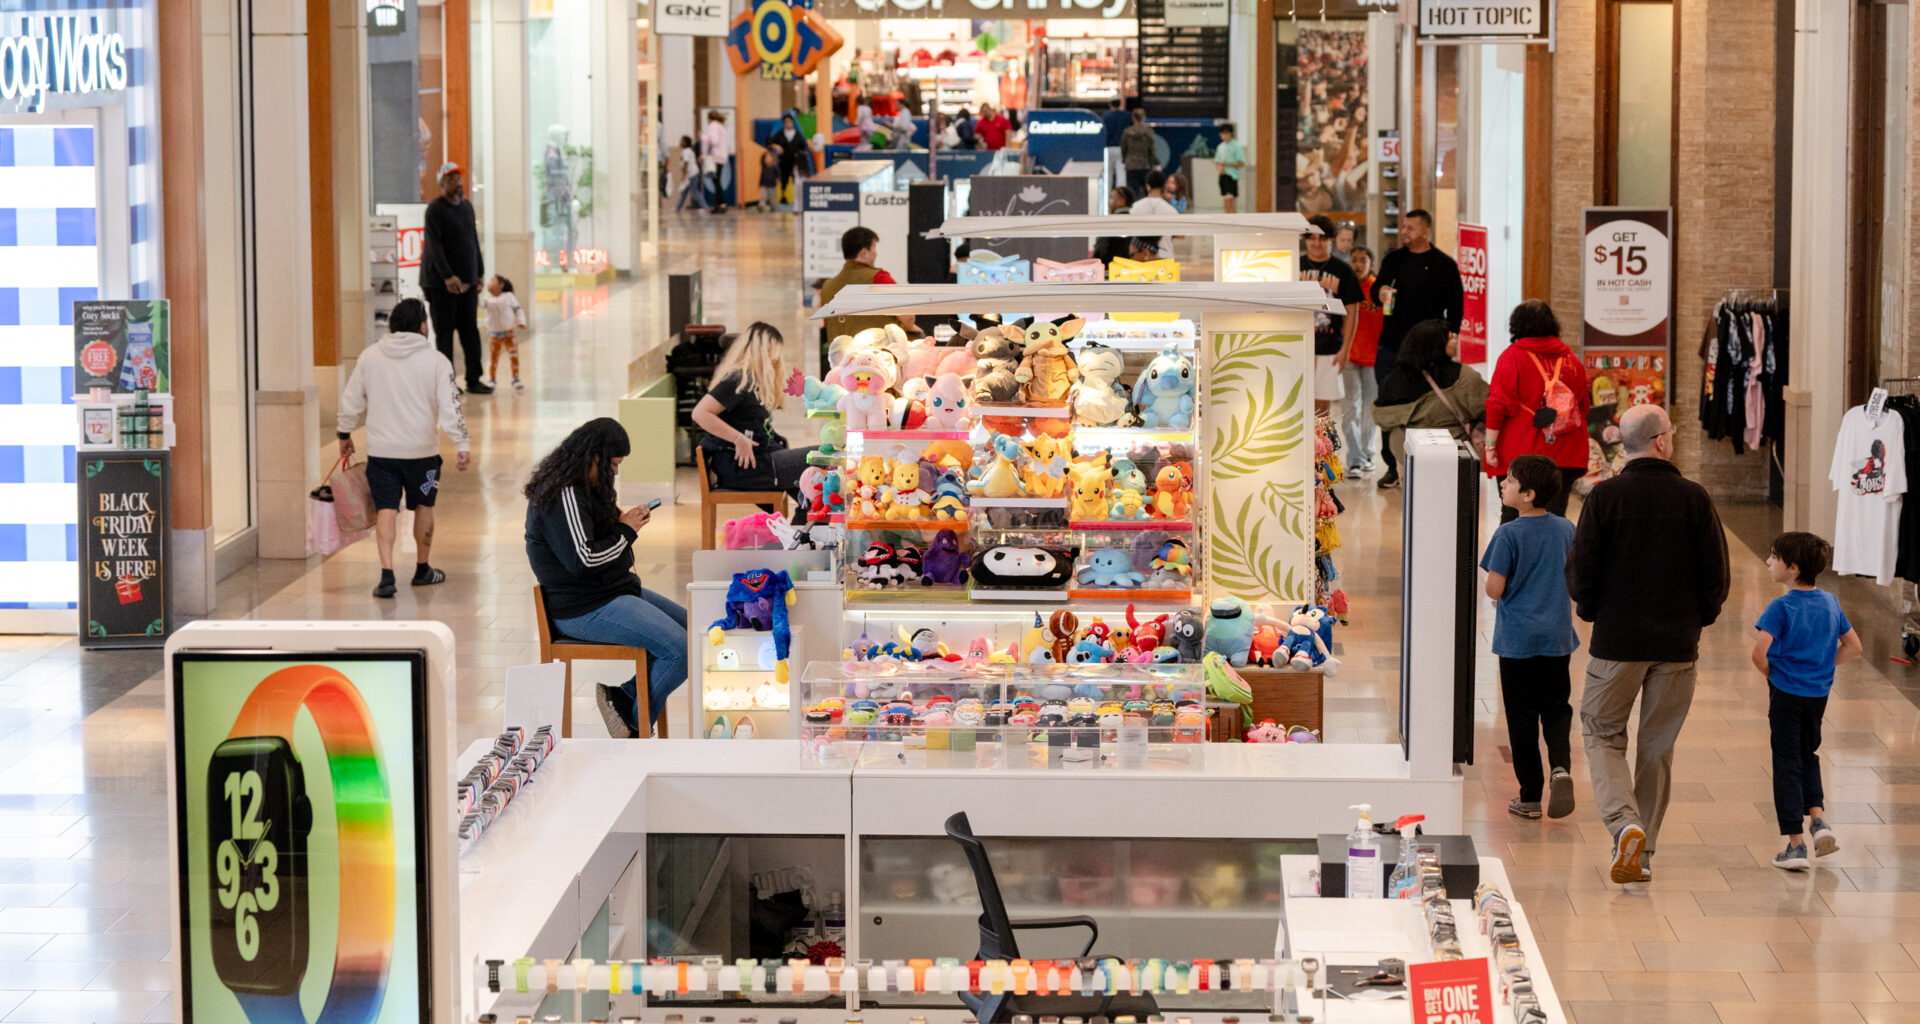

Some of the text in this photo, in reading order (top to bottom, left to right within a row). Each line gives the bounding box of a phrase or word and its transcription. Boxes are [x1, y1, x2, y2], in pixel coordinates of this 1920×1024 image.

[665, 5, 722, 18] GNC
[1429, 7, 1532, 25] HOT TOPIC
[726, 10, 822, 66] TOT
[50, 16, 127, 94] Works
[761, 62, 794, 80] LOT
[1029, 121, 1076, 134] Custom
[1612, 232, 1638, 242] GET
[1469, 247, 1486, 276] 50
[1594, 244, 1648, 276] $15
[1597, 279, 1652, 287] IN HOT CASH
[82, 311, 120, 322] Cozy Socks
[88, 351, 110, 362] FREE
[99, 492, 156, 514] BLACK
[93, 514, 156, 538] FRIDAY
[101, 538, 149, 557] WEEK
[95, 560, 156, 581] IS HERE!
[224, 769, 264, 840] 12
[216, 839, 280, 911] 9 3
[235, 891, 260, 962] 6
[1424, 984, 1480, 1013] BUY ONE
[1425, 1001, 1442, 1015] GET
